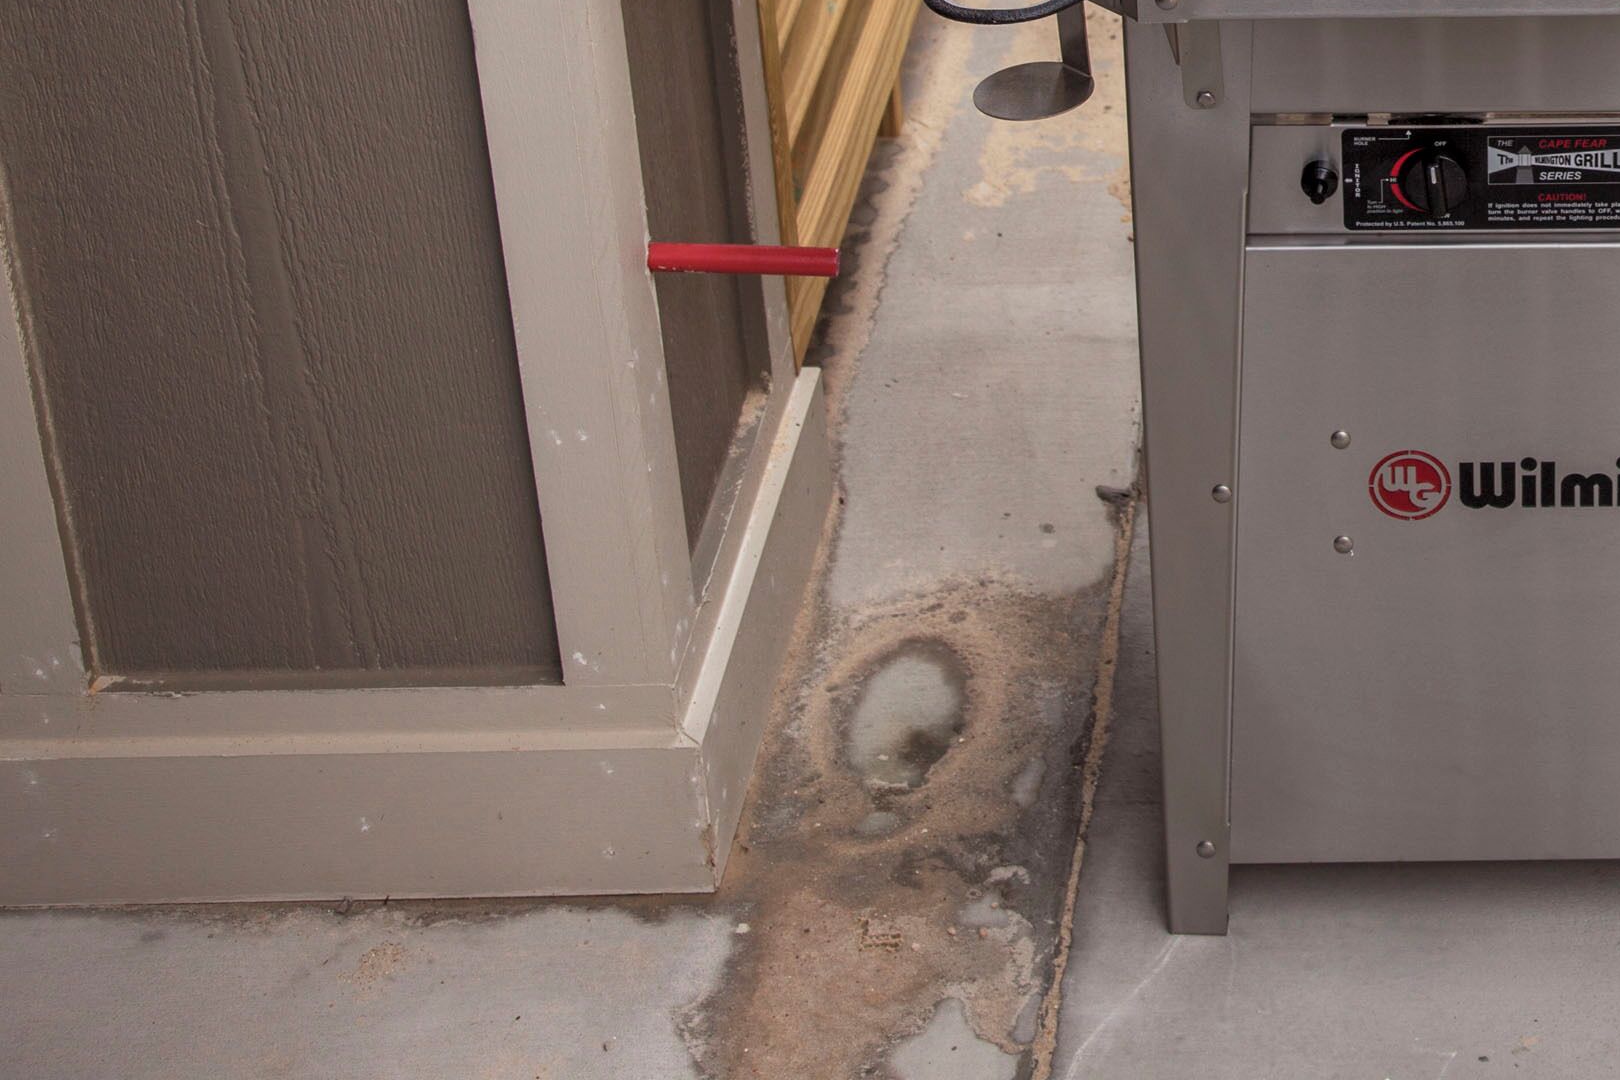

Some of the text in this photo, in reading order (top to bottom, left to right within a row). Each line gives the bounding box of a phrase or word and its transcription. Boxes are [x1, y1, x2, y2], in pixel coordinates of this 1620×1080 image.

[1539, 139, 1570, 148] CAPE
[1574, 138, 1607, 148] FEAR
[1540, 171, 1582, 180] SERIES
[1538, 193, 1587, 201] CAUTION!
